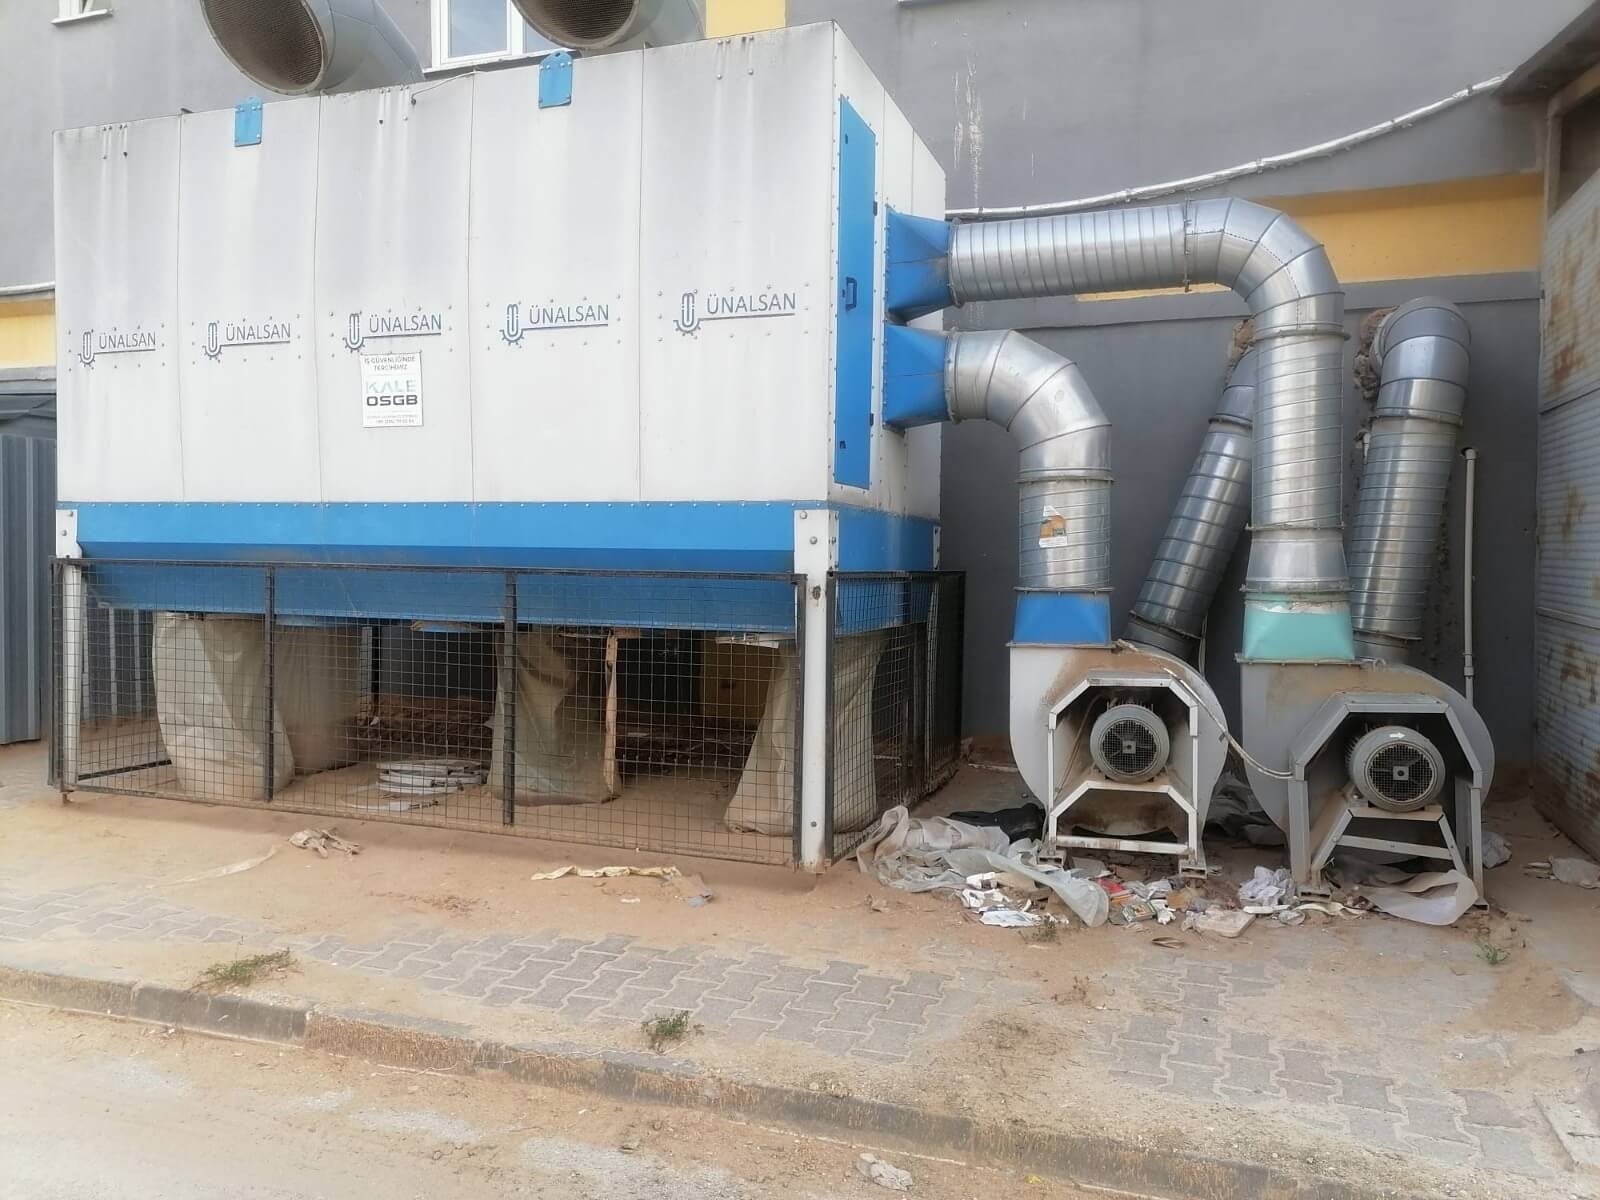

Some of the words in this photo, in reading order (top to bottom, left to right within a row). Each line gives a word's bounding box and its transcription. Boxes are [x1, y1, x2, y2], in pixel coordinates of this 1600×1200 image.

[707, 293, 796, 314] ÜNALSAN
[368, 313, 442, 334] ÜNALSAN
[529, 304, 609, 325] ÜNALSAN
[98, 331, 157, 350] ÜNALSAN
[225, 323, 291, 342] ÜNALSAN
[366, 380, 417, 393] KALE
[367, 395, 417, 406] OSGB
